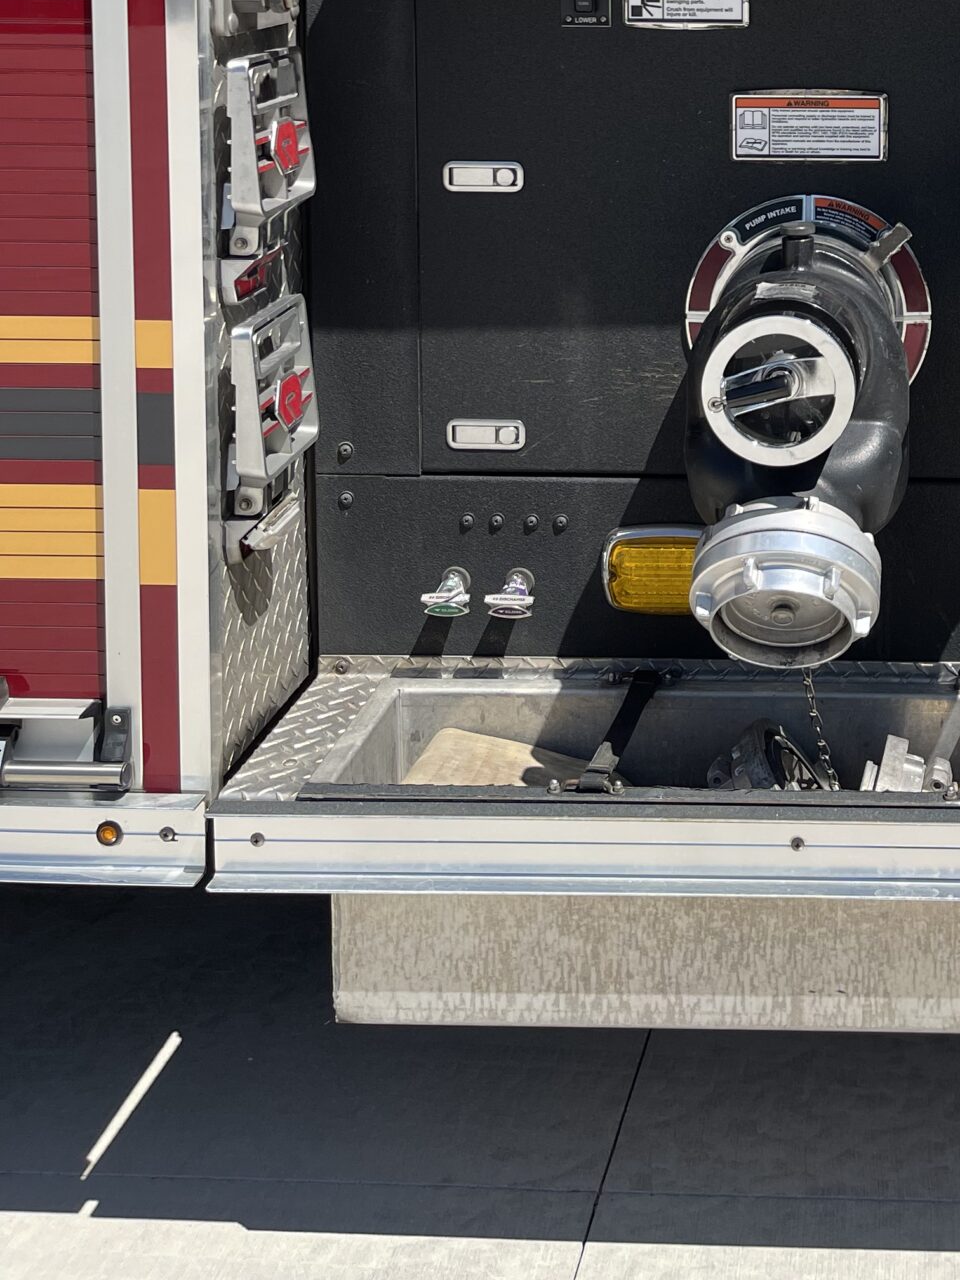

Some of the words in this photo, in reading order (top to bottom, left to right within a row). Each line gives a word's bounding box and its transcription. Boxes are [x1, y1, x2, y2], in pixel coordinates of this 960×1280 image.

[744, 214, 767, 230] PUMP
[766, 205, 797, 220] INTAKE
[834, 201, 870, 221] WARNING
